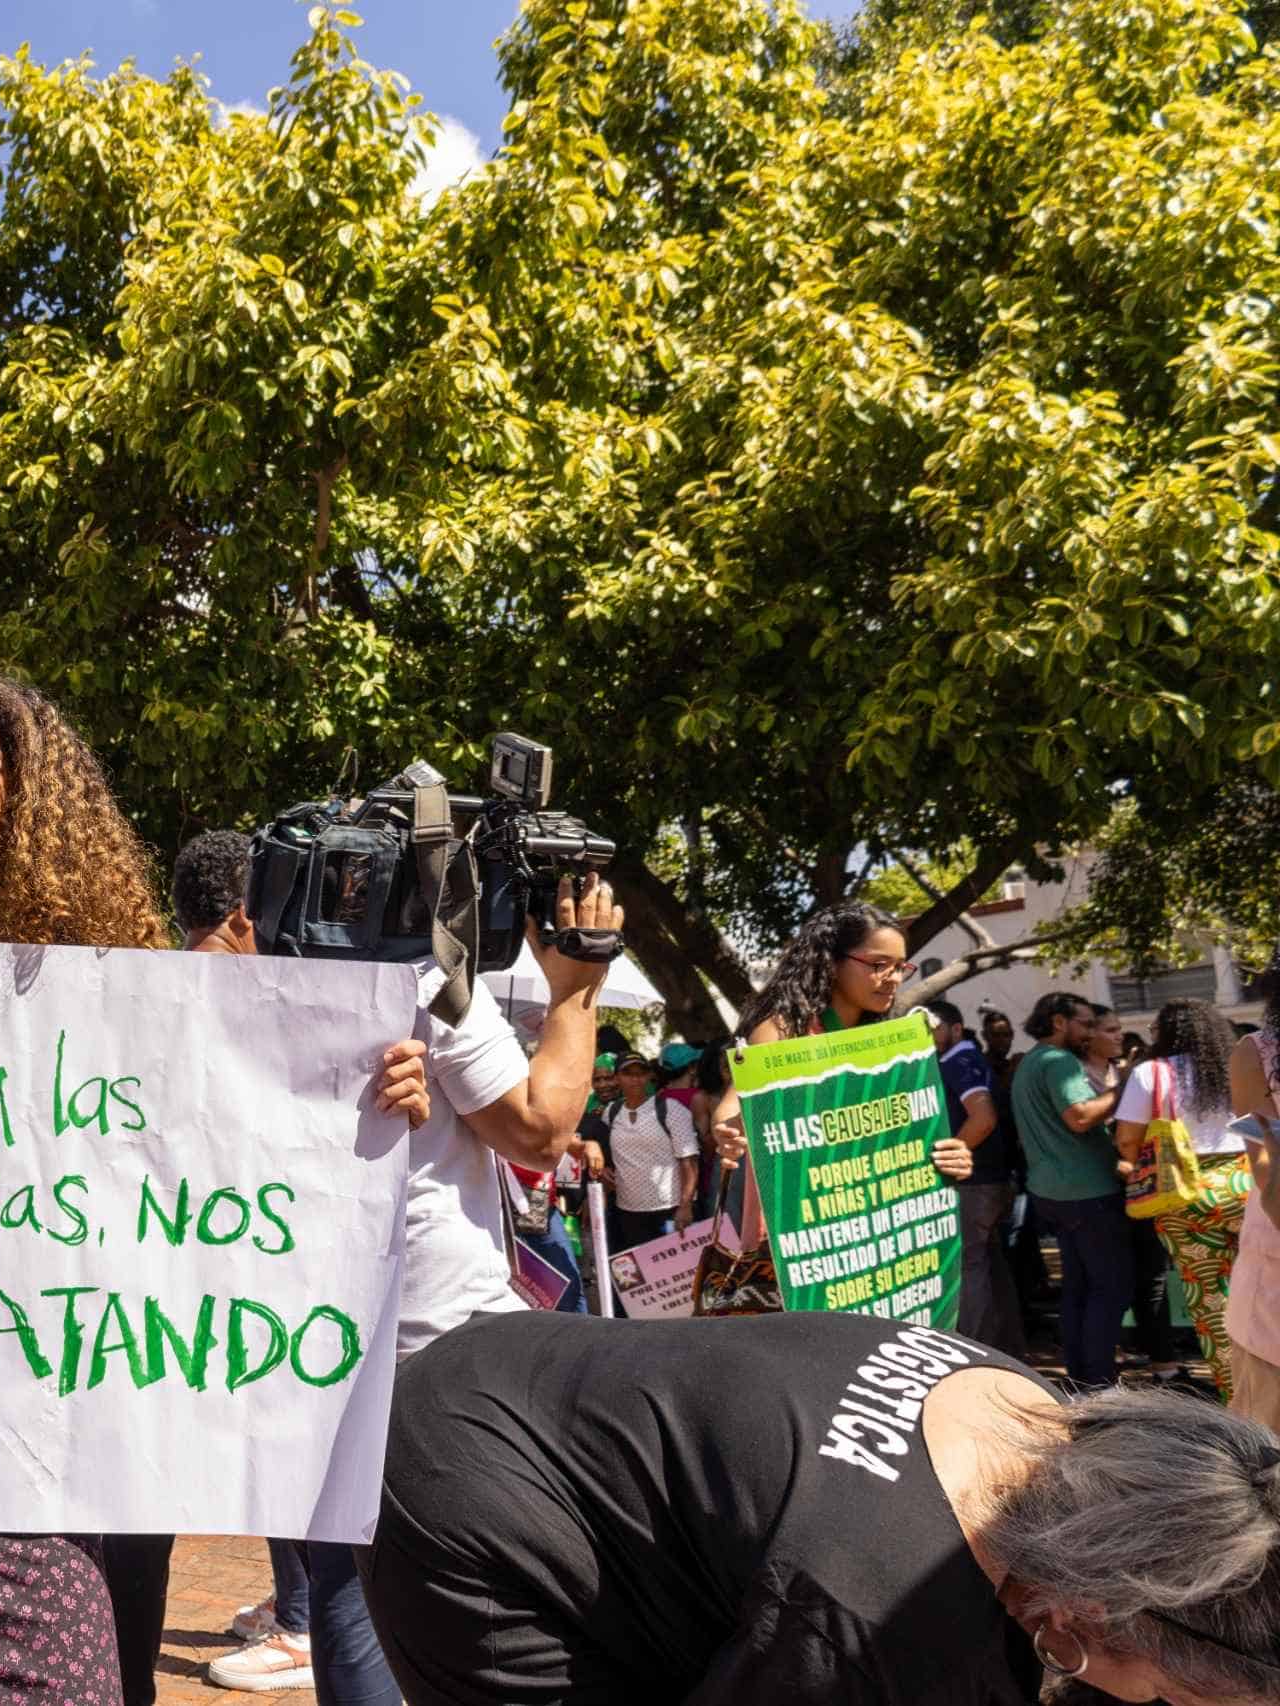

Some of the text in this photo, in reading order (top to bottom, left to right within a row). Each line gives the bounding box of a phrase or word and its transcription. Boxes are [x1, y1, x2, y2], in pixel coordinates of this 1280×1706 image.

[52, 1030, 147, 1137] las
[763, 1086, 940, 1155] #LASCAUSALESVAN
[800, 1164, 937, 1223] A NIÑAS Y MUJERES
[808, 1140, 924, 1191] PORQUE OBLIGAR
[135, 1176, 296, 1257] NOS
[778, 1186, 958, 1258] MANTENER UN EMBARAZO
[651, 1247, 677, 1263] #YO
[787, 1214, 957, 1288] RESULTADO DE UN DELITO
[826, 1248, 940, 1310] SOBRE SU CUERPO
[629, 1284, 653, 1298] POR
[655, 1279, 670, 1288] EL
[641, 1296, 657, 1306] LA
[873, 1297, 891, 1319] SU
[891, 1275, 942, 1316] DERECHO
[819, 1326, 988, 1482] LOGISTICA
